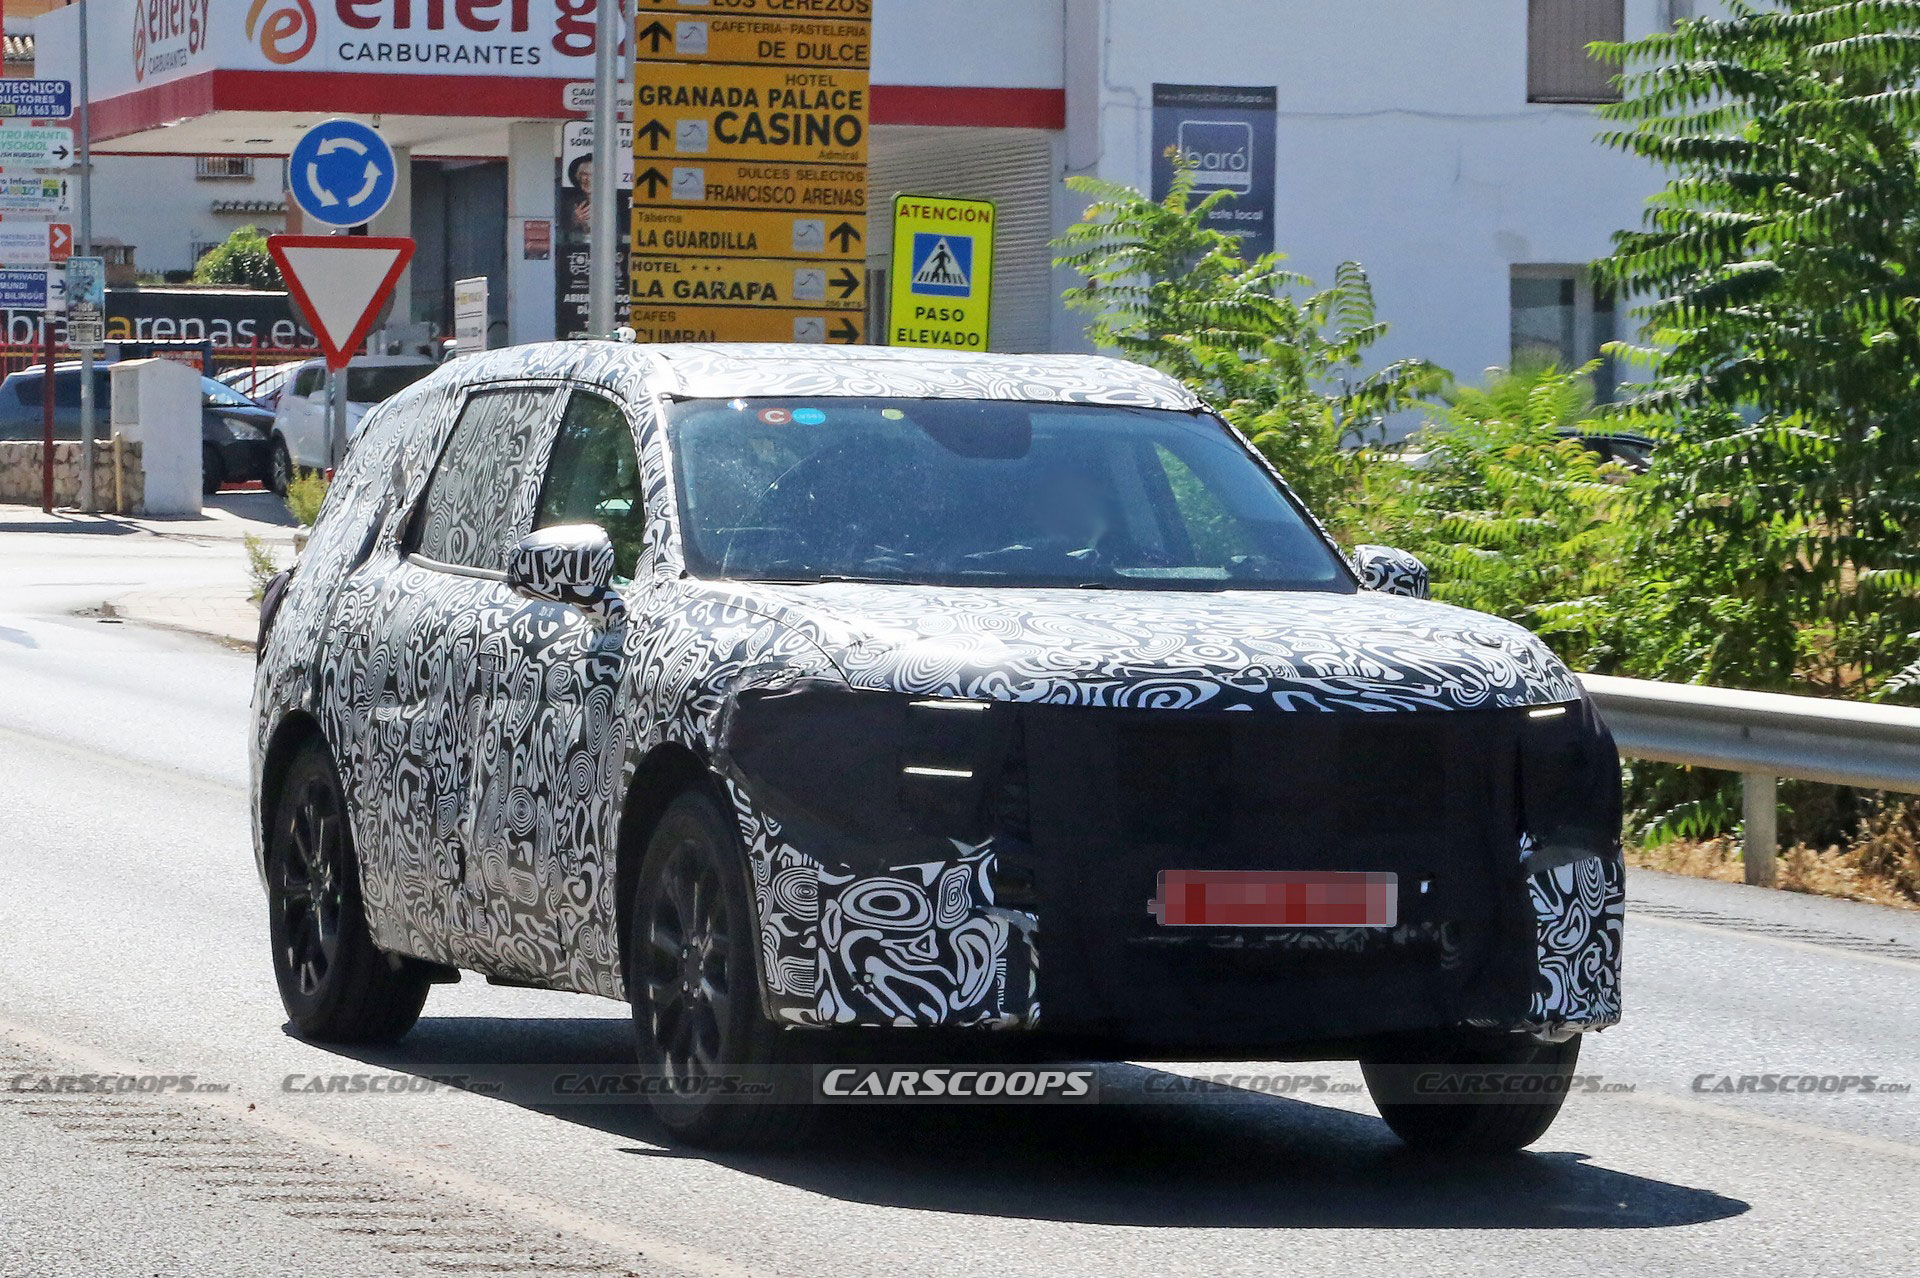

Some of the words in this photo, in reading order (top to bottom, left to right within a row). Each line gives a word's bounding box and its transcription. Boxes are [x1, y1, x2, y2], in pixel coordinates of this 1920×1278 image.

[336, 0, 625, 57] energ
[339, 42, 541, 65] CARBURANTES
[758, 41, 786, 59] DE
[797, 43, 868, 61] DULCE
[785, 73, 837, 87] HOTEL
[638, 85, 759, 108] GRANADA
[768, 88, 862, 110] PALACE
[713, 110, 862, 147] CASINO
[738, 167, 790, 181] DULCES
[797, 169, 865, 183] SELECTOS
[705, 183, 796, 204] FRANCISCO
[803, 187, 865, 207] ARENAS
[638, 211, 683, 224] Taberna
[899, 203, 990, 223] ATENCIÓN
[637, 229, 657, 247] LA
[663, 230, 757, 250] GUARDILLA
[631, 260, 681, 273] HOTEL
[631, 279, 664, 298] LA
[673, 280, 777, 301] GARAPA
[632, 310, 677, 322] CAFES
[915, 306, 964, 322] PASO
[897, 328, 980, 346] ELEVADO
